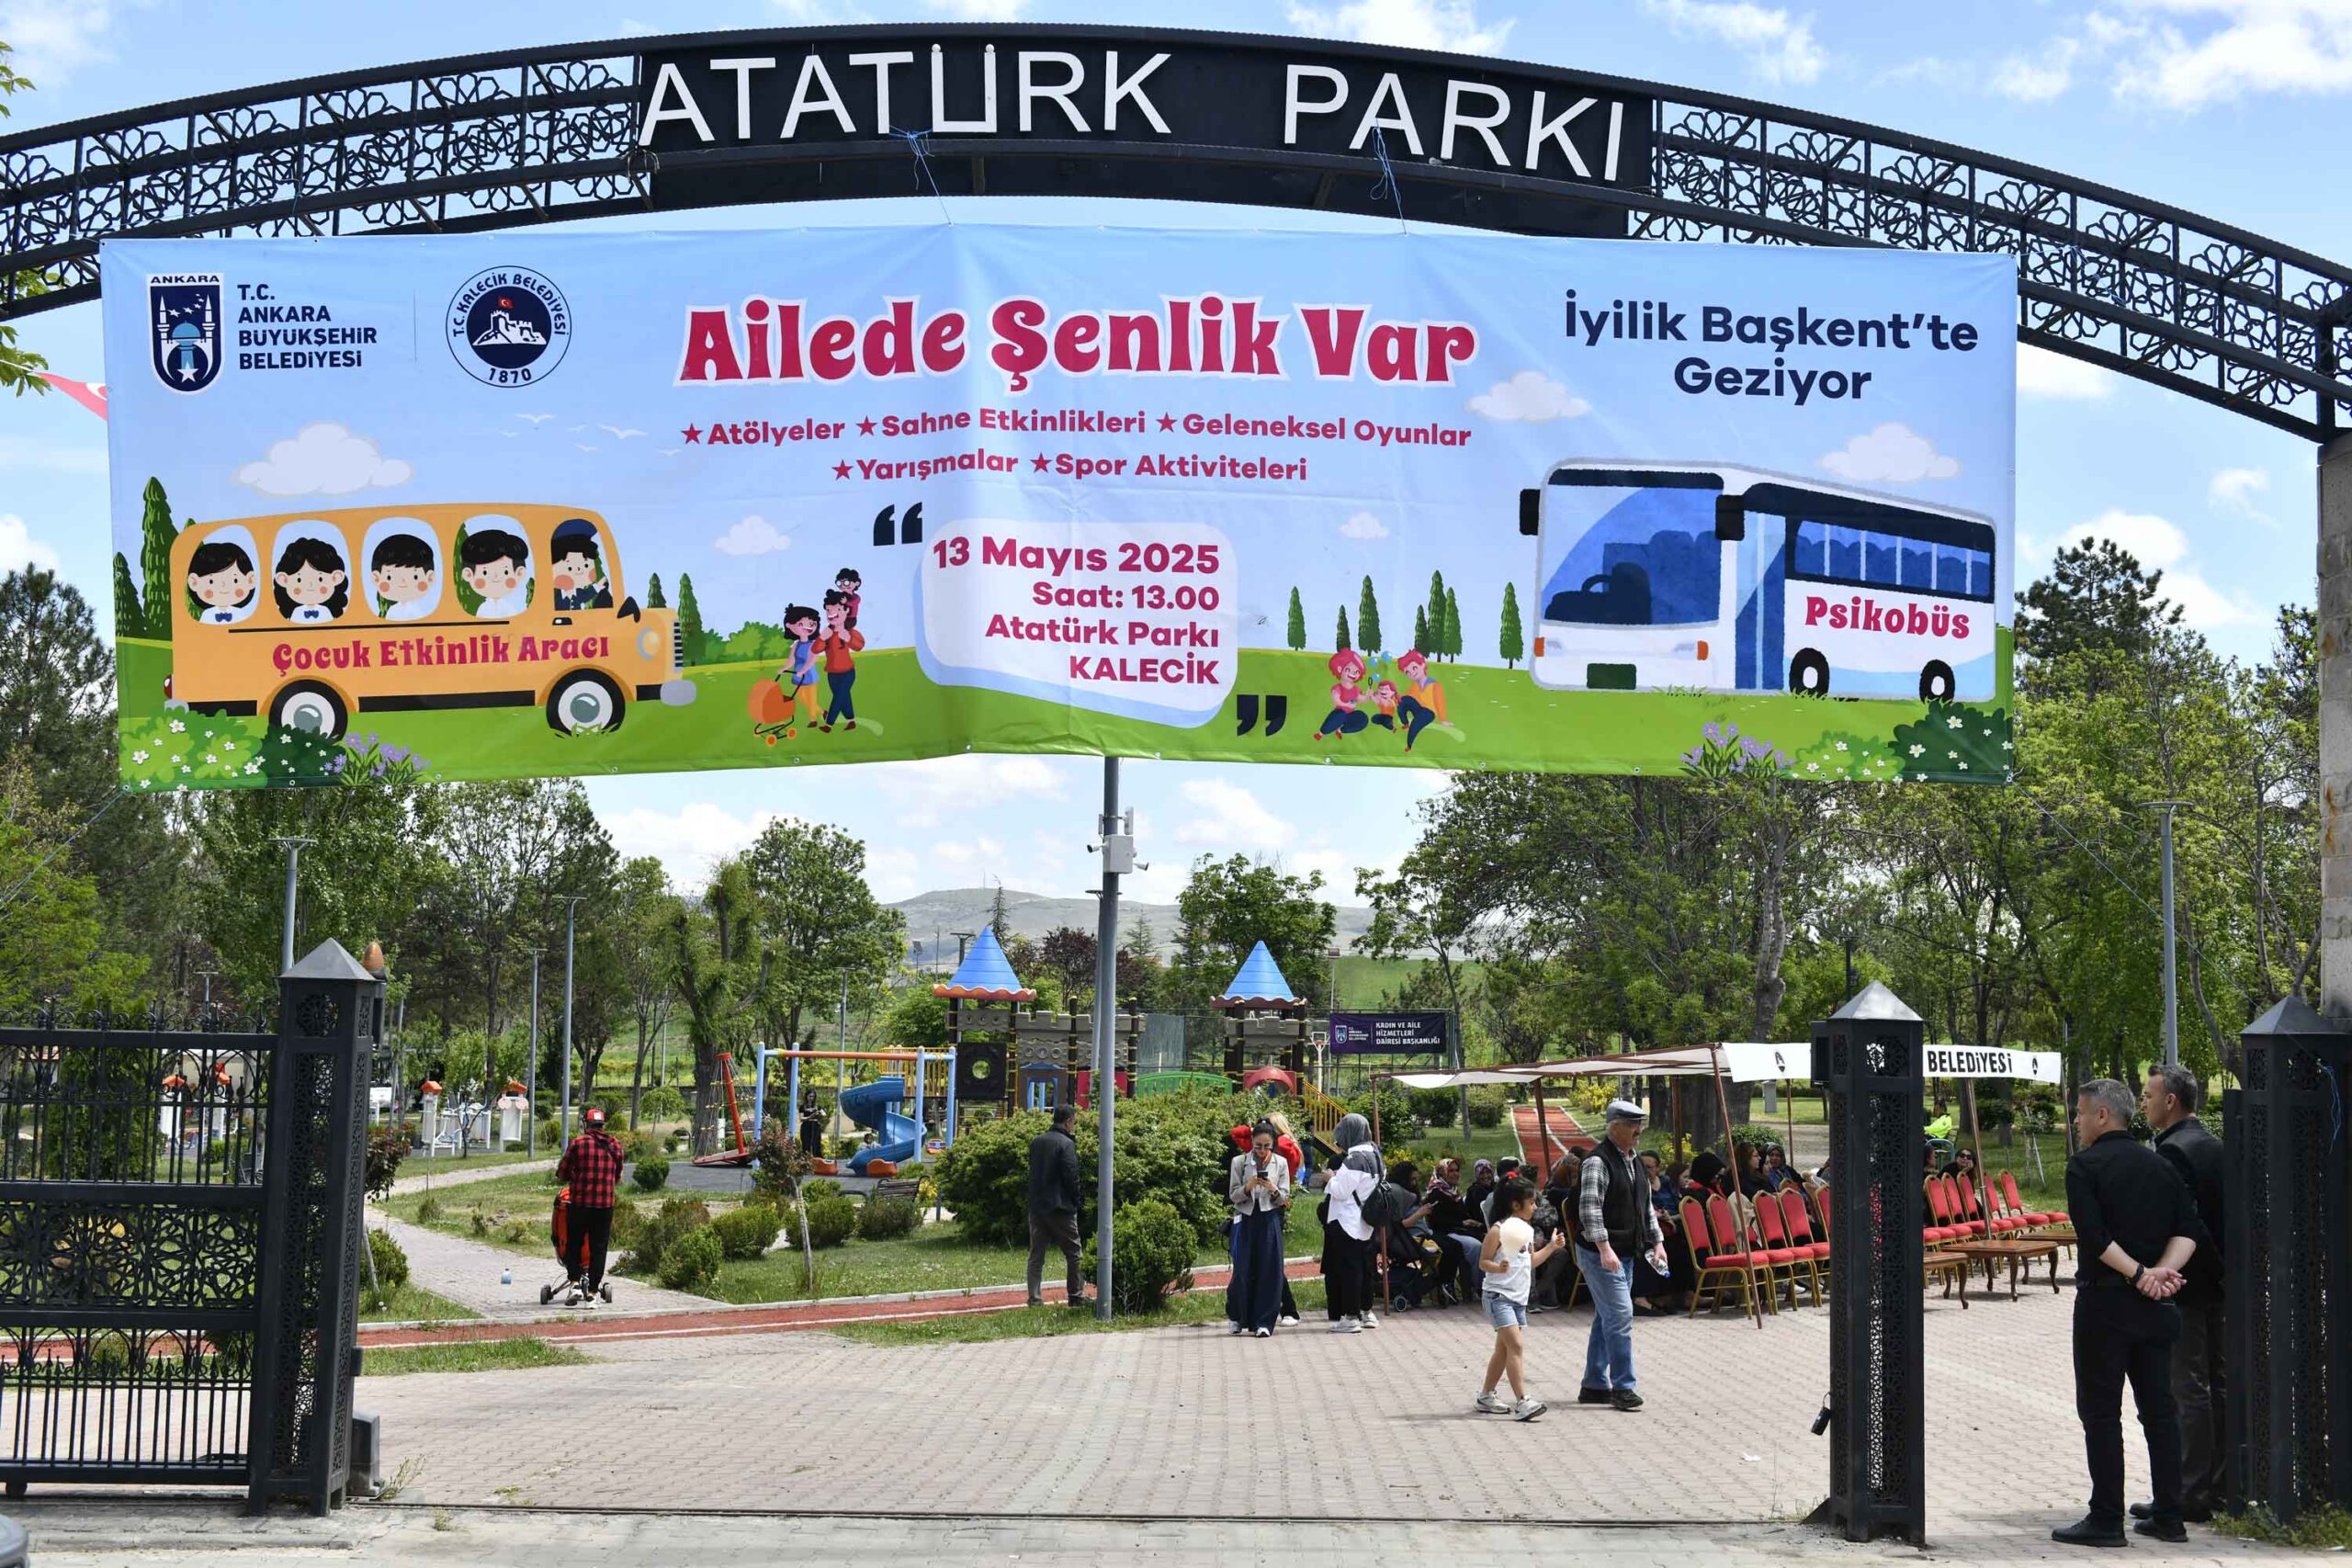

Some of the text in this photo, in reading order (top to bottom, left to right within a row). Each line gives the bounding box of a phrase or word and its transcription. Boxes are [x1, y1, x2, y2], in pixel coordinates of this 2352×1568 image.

[639, 43, 1623, 181] ATATÜRK PARKI
[151, 276, 220, 284] ANKARA
[237, 284, 275, 300] T.C.
[238, 305, 332, 323] ANKARA
[457, 272, 507, 313] KALECİK
[513, 274, 569, 335] BELEDİYESİ
[1566, 288, 1978, 352] İyilik Başkent'te
[677, 294, 1476, 393] Ailede Şenlik Var
[489, 367, 532, 383] 1870
[1674, 356, 1871, 405] Geziyor
[707, 409, 1471, 446] Atölyeler Sahne Etkinlikleri Geleneksel Oyunlar
[857, 448, 1307, 480] Yarışmalar Spor Aktiviteleri
[933, 536, 1219, 576] 13 Mayıs 2025
[1033, 582, 1219, 611] Saat: 13.00
[986, 615, 1219, 648] Atatürk Parkı
[1804, 596, 1970, 639] Psikobüs
[273, 635, 609, 676] Çocuk Etkinlik Aracı
[1069, 652, 1219, 683] KALECİK
